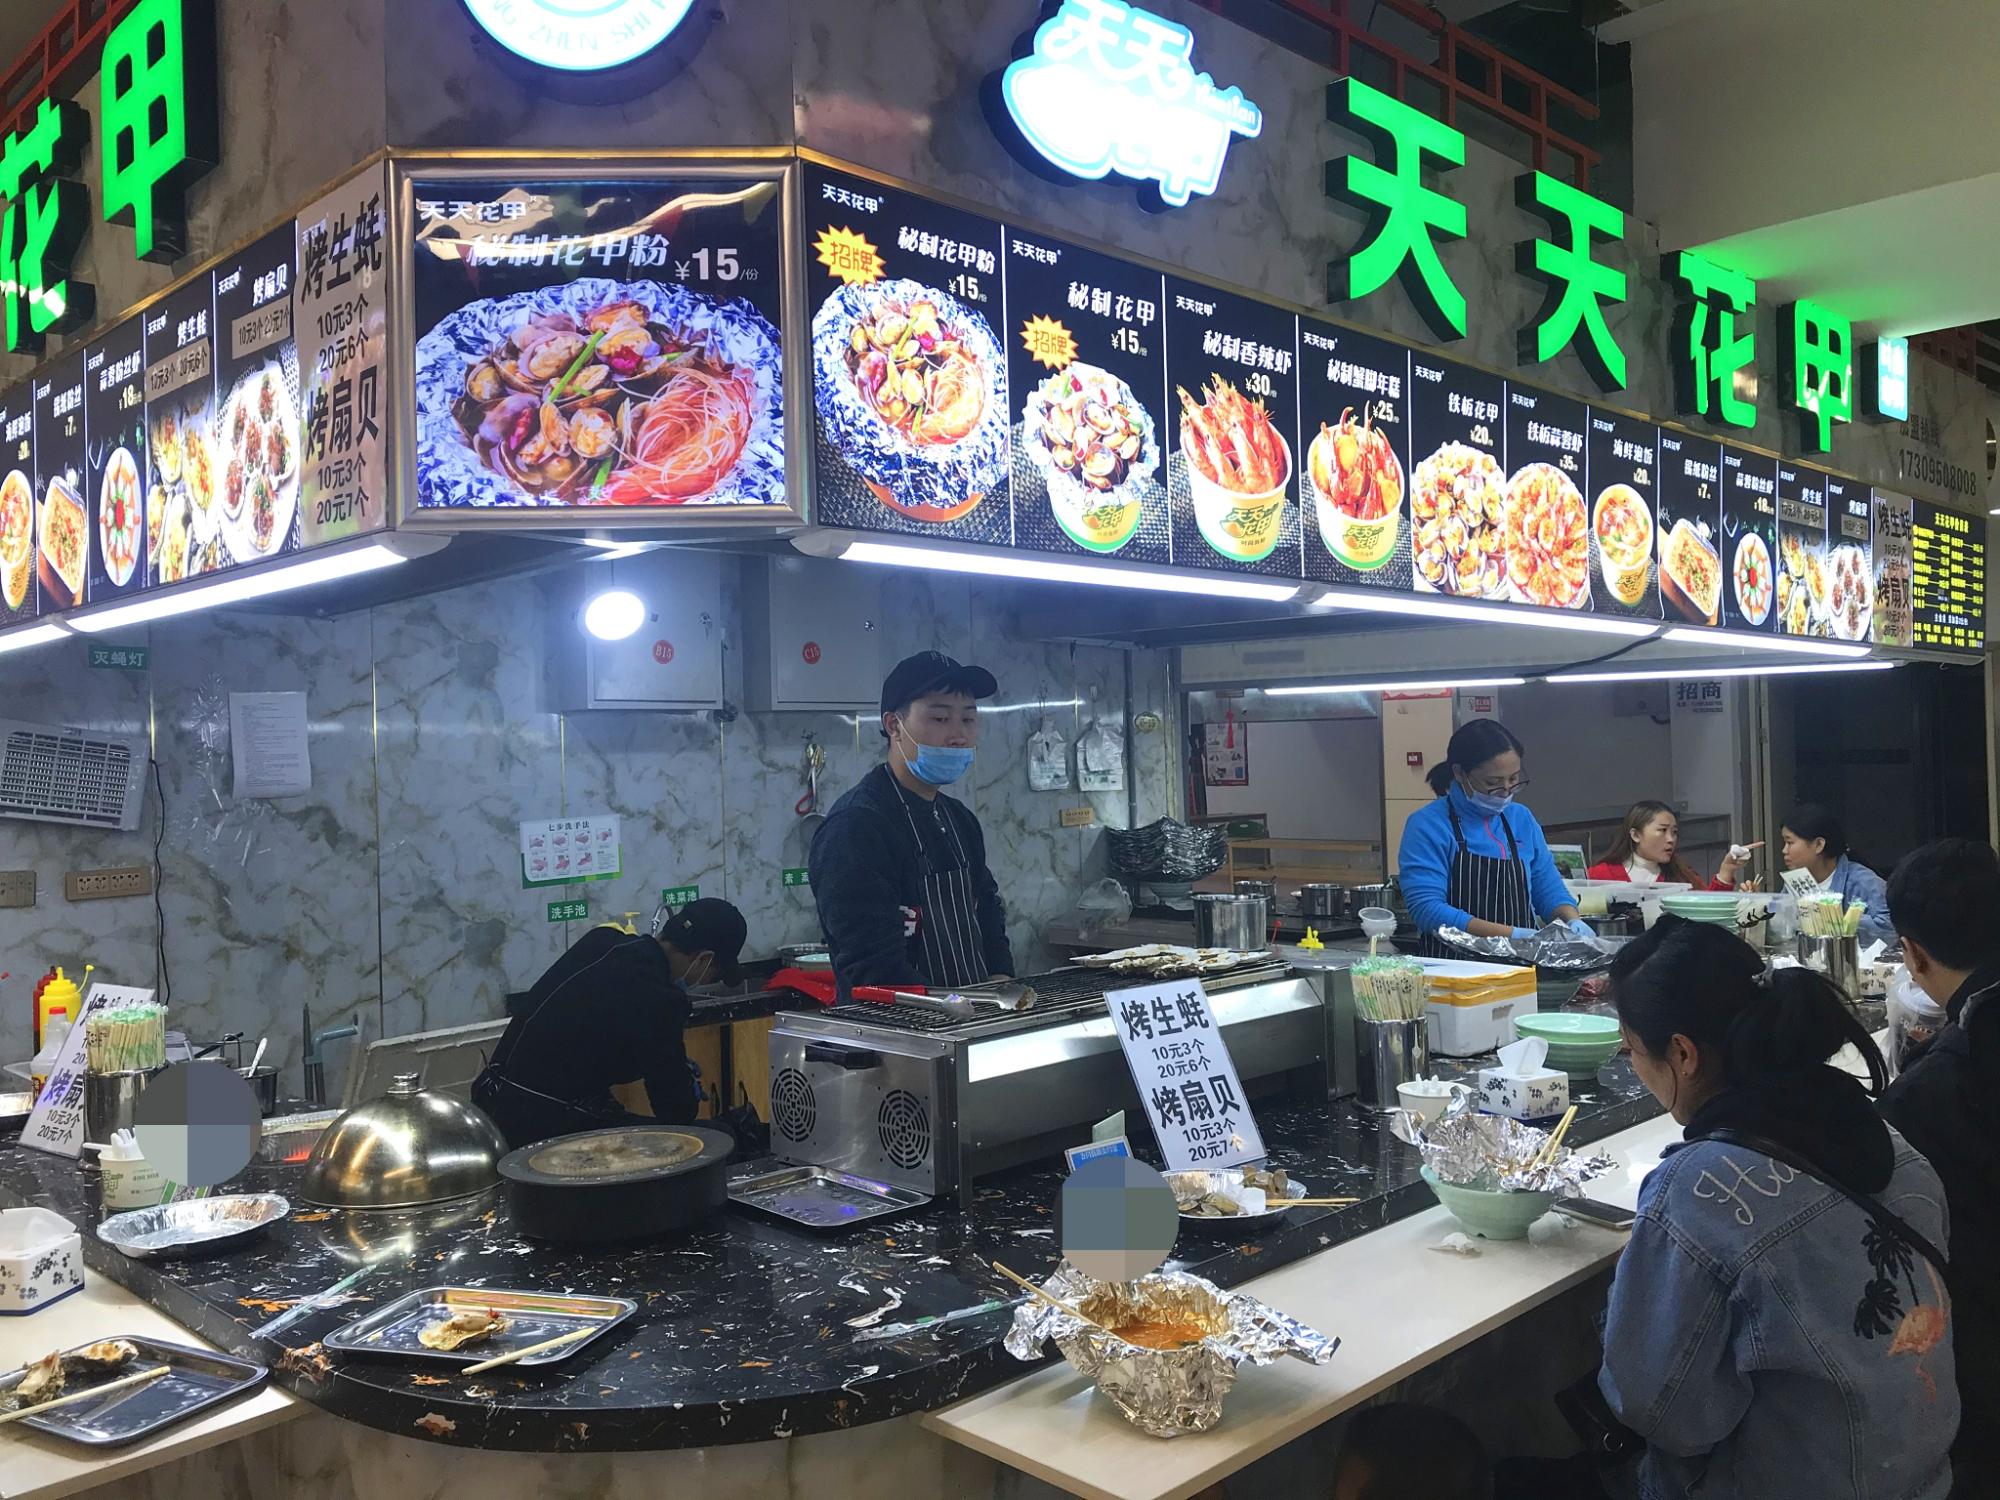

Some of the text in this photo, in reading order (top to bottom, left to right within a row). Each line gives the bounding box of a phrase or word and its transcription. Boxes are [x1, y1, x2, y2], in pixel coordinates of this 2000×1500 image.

[419, 200, 527, 222] 天天花甲
[822, 183, 879, 214] 天天花甲
[301, 192, 382, 306] 烤生蚝
[465, 233, 670, 268] 秘制花甲粉
[830, 241, 874, 275] 招牌
[897, 225, 995, 275] 秘制花甲粉
[1012, 239, 1058, 266] 天天花甲
[1347, 76, 1852, 453] 天天花甲
[252, 263, 287, 307] 烤扇贝
[317, 293, 369, 339] 10元3个
[1067, 280, 1156, 327] 秘制花甲
[1176, 295, 1213, 317] 天天花甲
[177, 310, 207, 348] 烤生蚝
[1033, 327, 1068, 355] 招牌
[1303, 331, 1336, 351] 天天花甲
[319, 328, 369, 373] 20元6个
[1202, 329, 1292, 375] 秘制香辣虾
[1415, 365, 1442, 383] 天天花甲
[305, 365, 380, 464] 烤扇贝
[1448, 391, 1499, 423] 铁板花甲
[1527, 420, 1584, 454] 铁板蒜蓉虾
[1613, 438, 1653, 465] 海鲜泡饭
[317, 455, 367, 491] 10元3个
[316, 489, 369, 525] 20元7个
[1677, 681, 1722, 700] 招商
[548, 820, 590, 832] 七步洗手法
[551, 904, 587, 920] 洗手池
[665, 890, 698, 904] 洗菜池
[1121, 991, 1210, 1041] 烤生蚝
[1151, 1038, 1205, 1061] 10元3个
[1157, 1056, 1212, 1079] 20元6个
[44, 1068, 84, 1110] 烤扇
[1151, 1074, 1241, 1129] 烤扇贝
[37, 1124, 73, 1145] 20元7个
[46, 1109, 81, 1129] 10元3个
[1182, 1118, 1236, 1143] 10元3个
[1188, 1137, 1241, 1162] 20元7个
